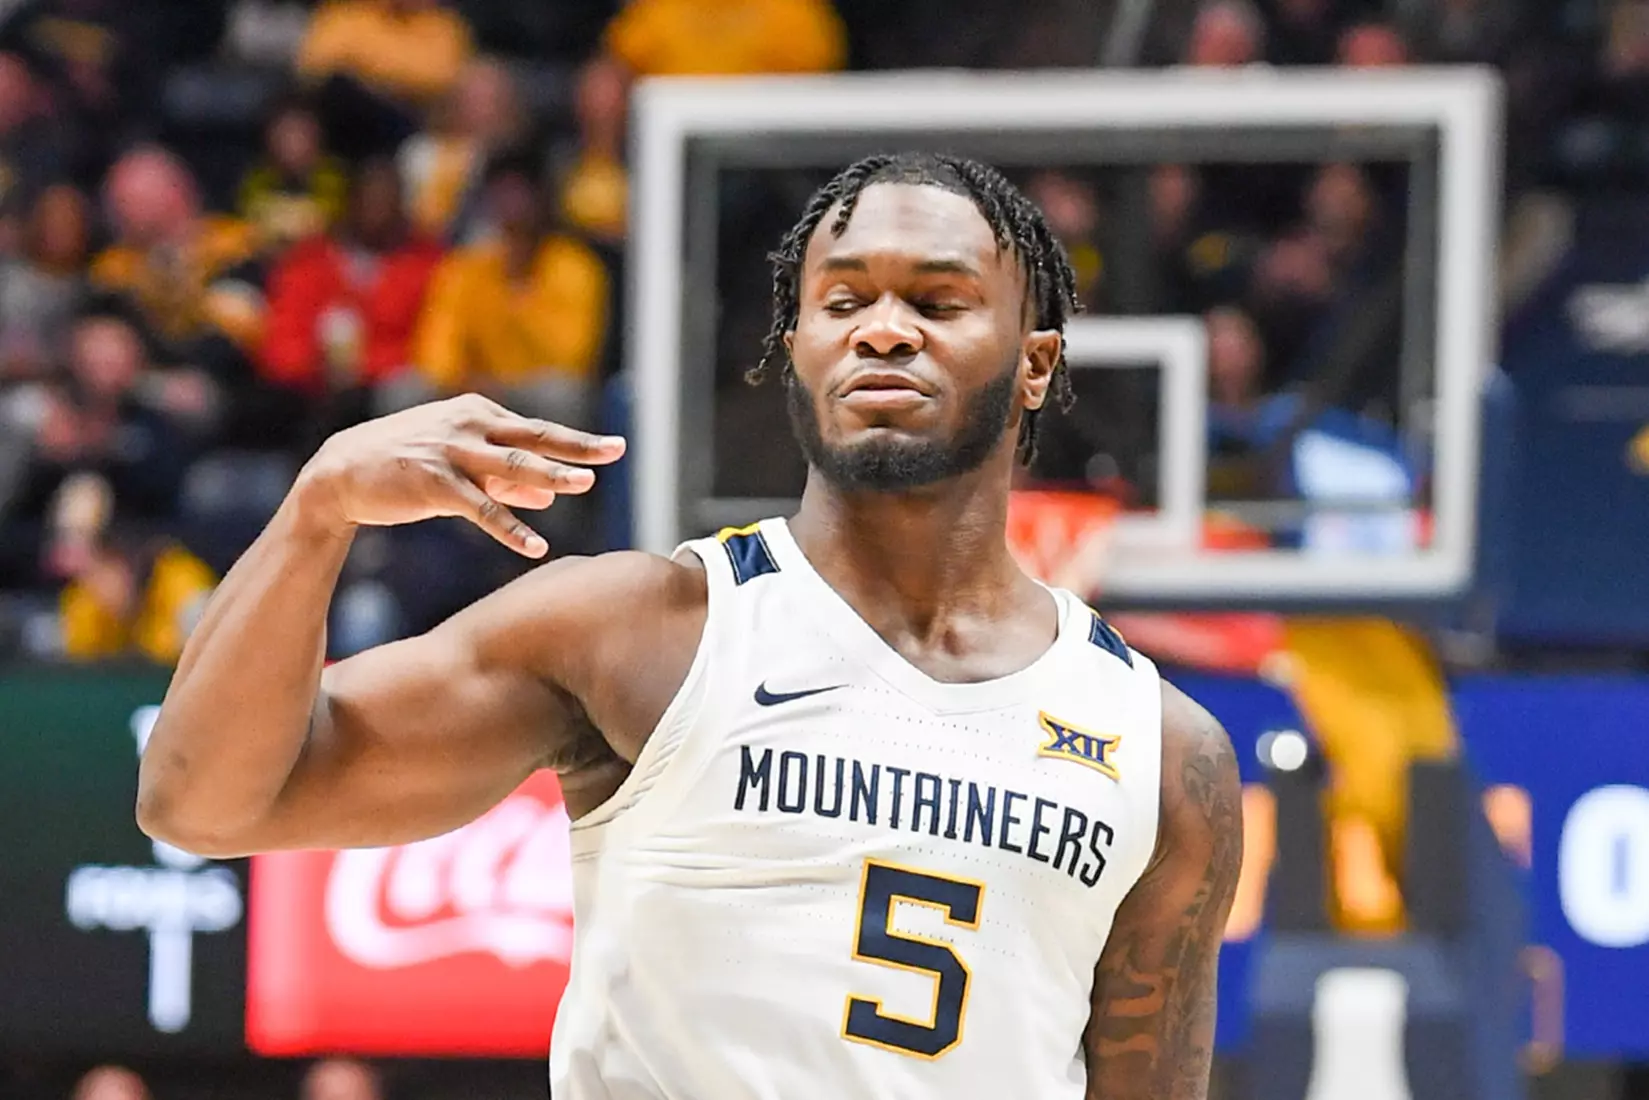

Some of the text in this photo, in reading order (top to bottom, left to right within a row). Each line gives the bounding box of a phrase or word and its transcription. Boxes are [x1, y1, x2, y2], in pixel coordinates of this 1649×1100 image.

[734, 745, 1114, 888] MOUNTAINEERS
[1040, 712, 1119, 778] XII
[840, 857, 985, 1061] 5
